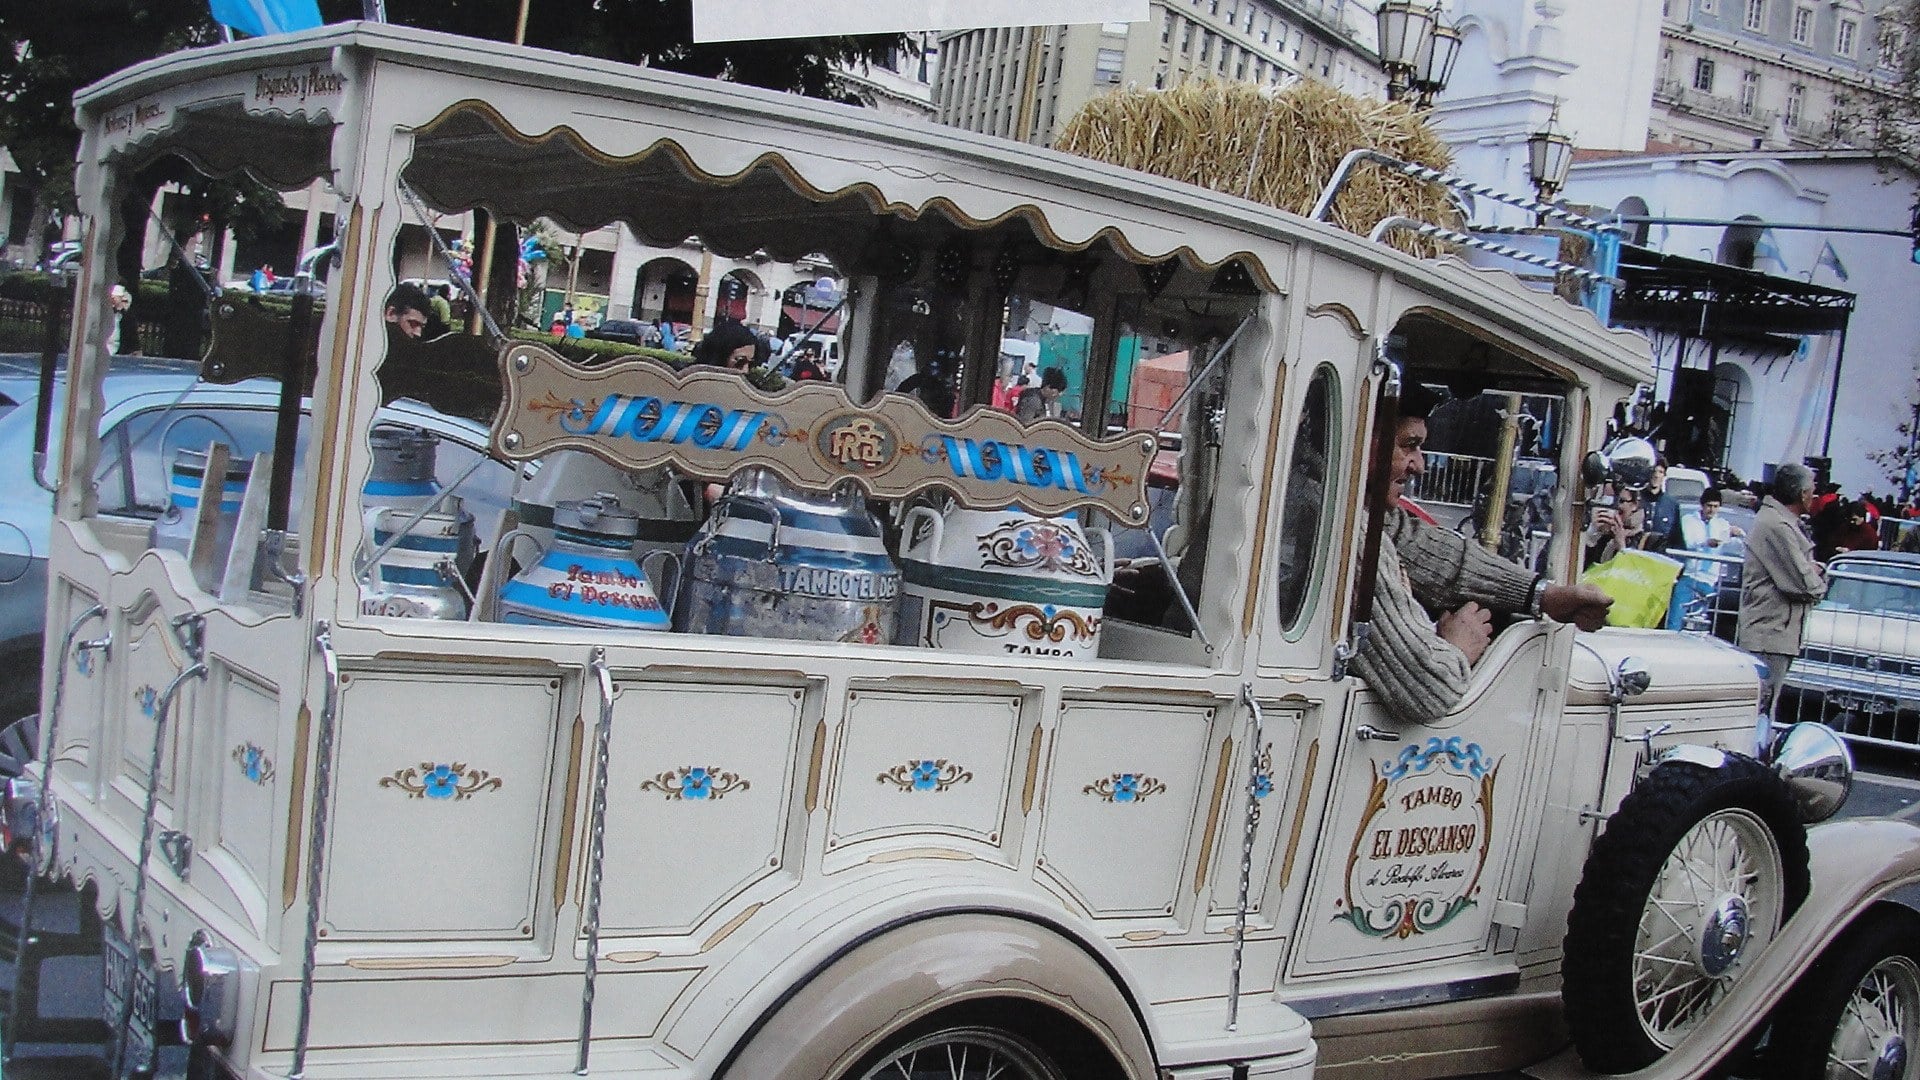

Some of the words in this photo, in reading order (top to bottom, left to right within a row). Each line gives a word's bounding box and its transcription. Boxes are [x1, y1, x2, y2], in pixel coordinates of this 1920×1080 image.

[781, 566, 851, 599] TAMBO
[1401, 785, 1462, 813] TAMBO
[1369, 829, 1393, 860] EL
[1394, 823, 1476, 857] DESCANSO
